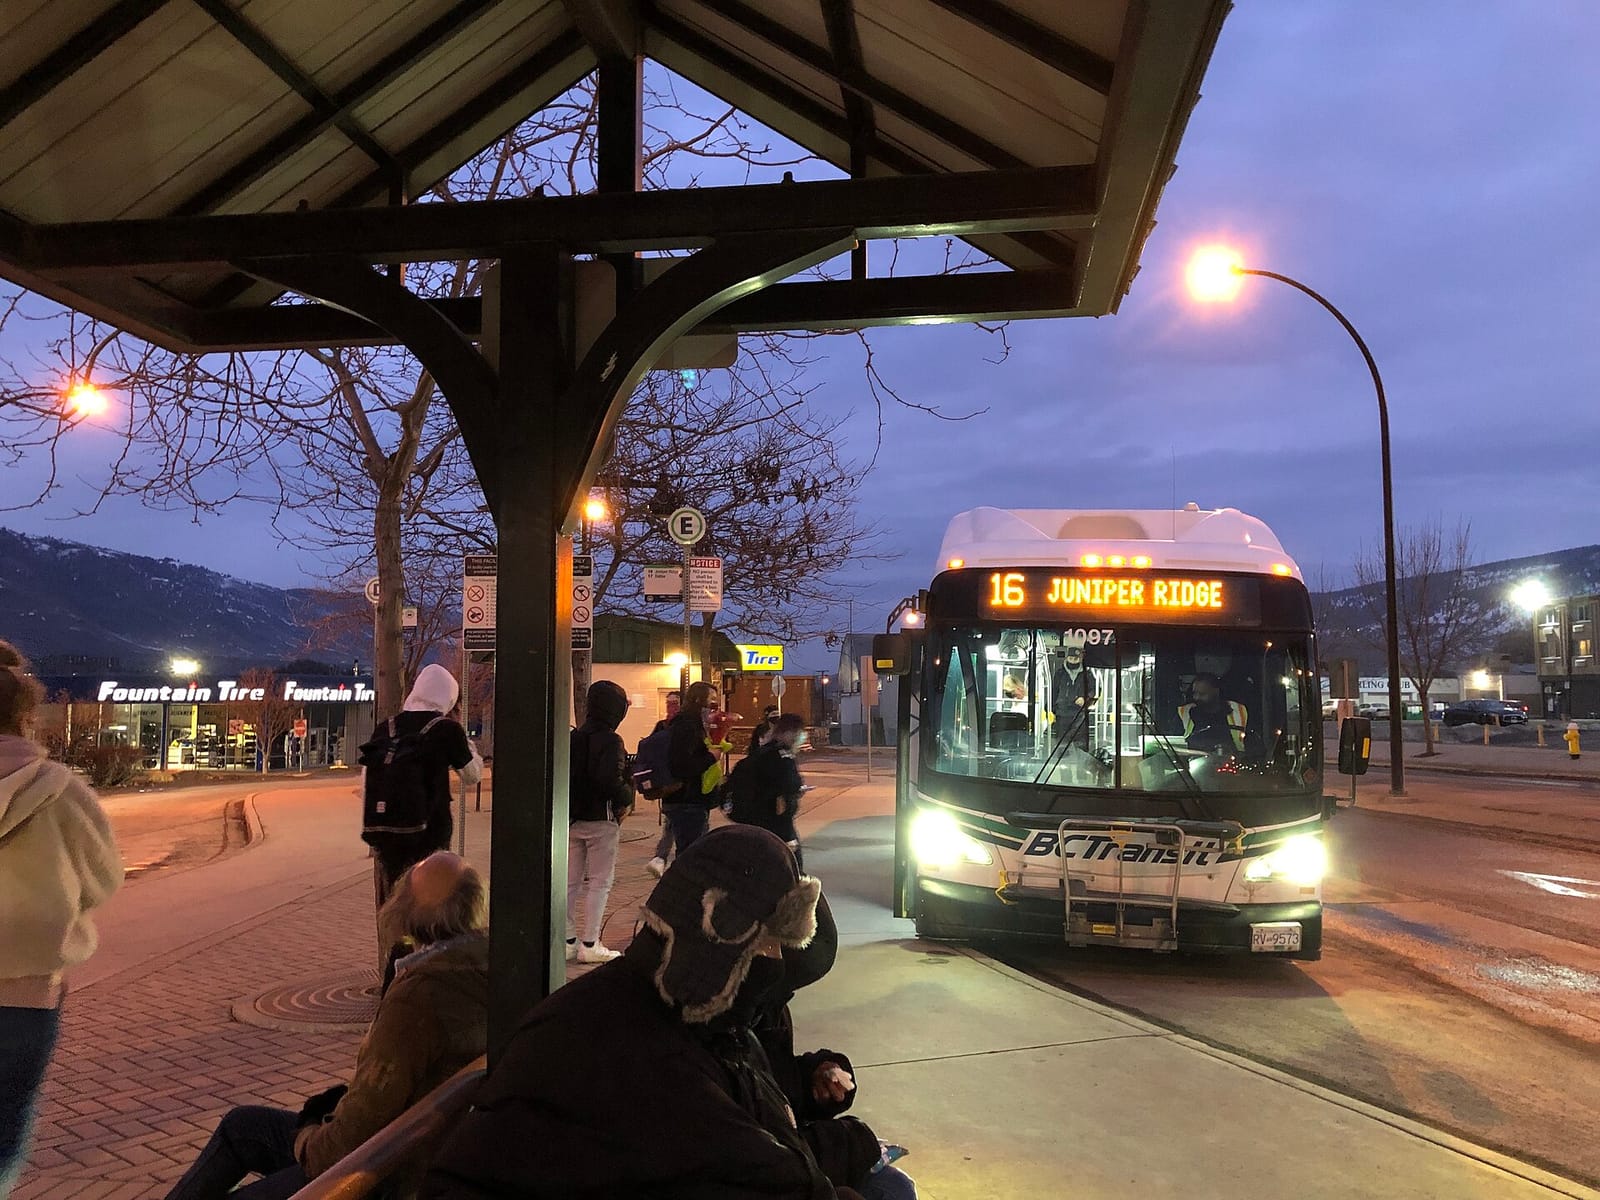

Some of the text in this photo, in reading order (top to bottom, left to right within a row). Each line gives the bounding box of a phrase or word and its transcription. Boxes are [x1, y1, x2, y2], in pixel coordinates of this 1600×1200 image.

[680, 517, 693, 534] E
[690, 560, 719, 568] NOTICE
[990, 573, 1223, 608] 16 JUNIPER RIDGE
[1064, 628, 1114, 646] 1097
[746, 651, 779, 664] Tire
[97, 681, 265, 702] Fountain Tire
[284, 681, 374, 702] Fountain Tir
